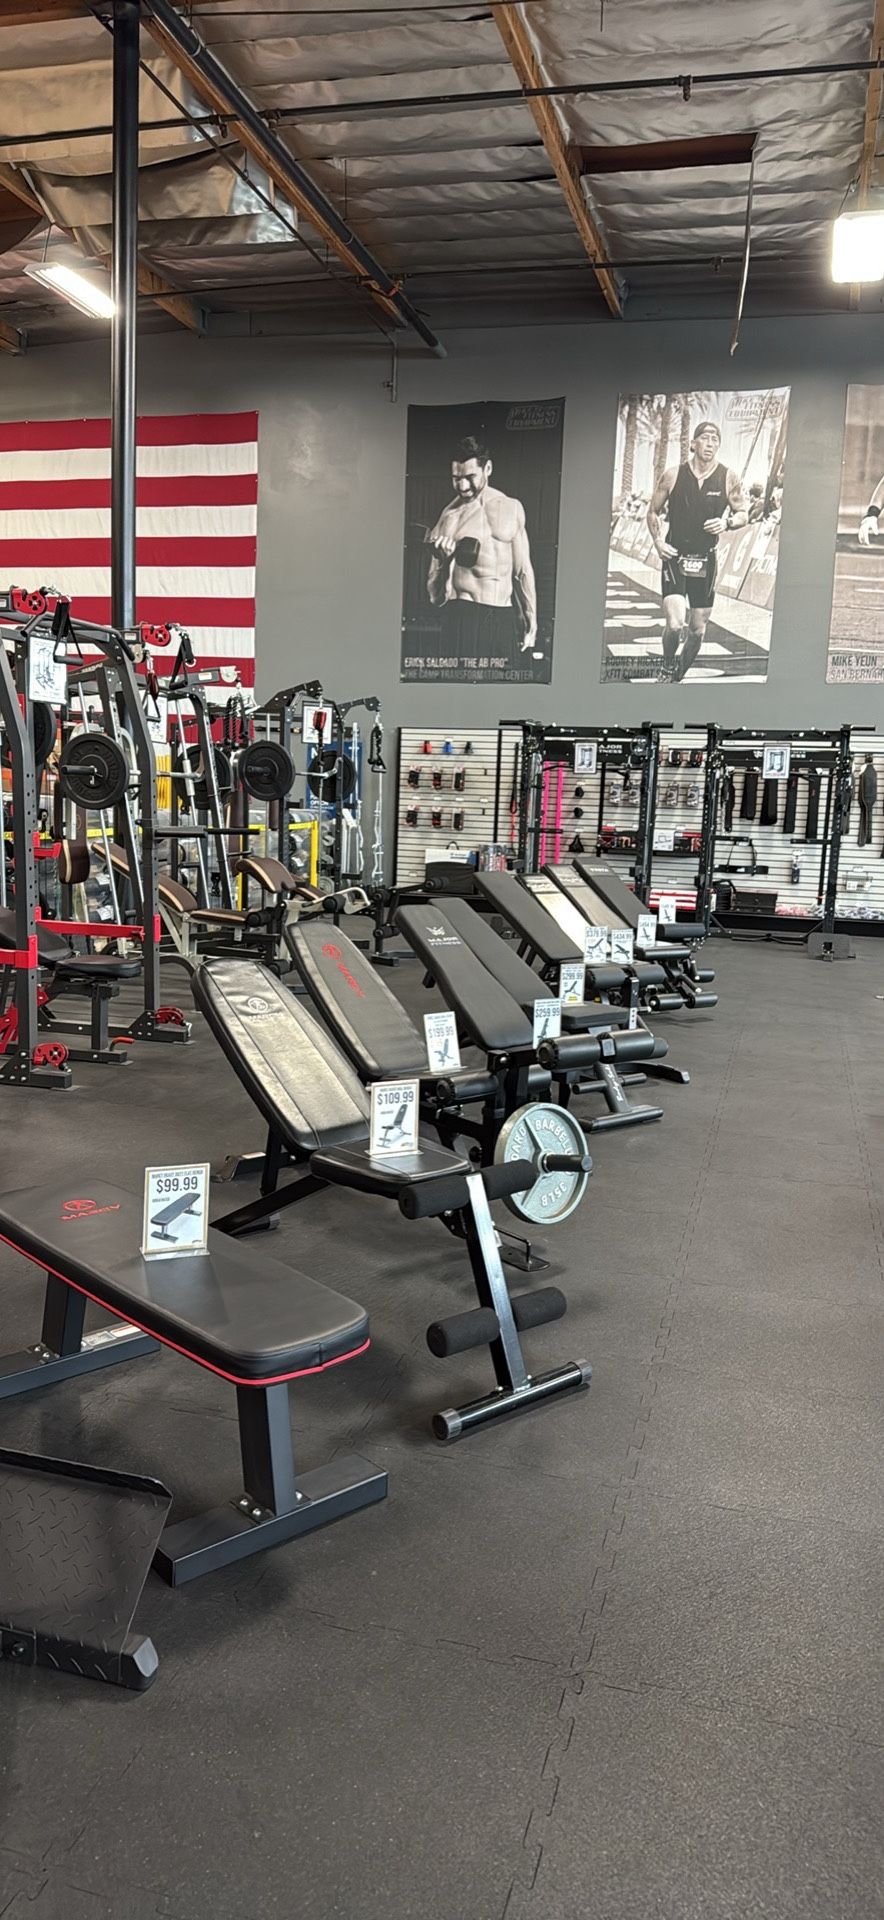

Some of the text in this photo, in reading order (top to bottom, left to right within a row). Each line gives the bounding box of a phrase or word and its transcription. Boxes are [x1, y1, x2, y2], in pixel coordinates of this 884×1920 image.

[404, 657, 425, 668] ERICK
[479, 657, 489, 668] AB
[490, 657, 508, 668] PRO"
[832, 655, 877, 667] MIKE YEUN
[505, 669, 534, 681] CENTER
[377, 1090, 414, 1106] $109.99
[511, 1126, 527, 1161] DARD
[156, 1176, 198, 1194] $99.99
